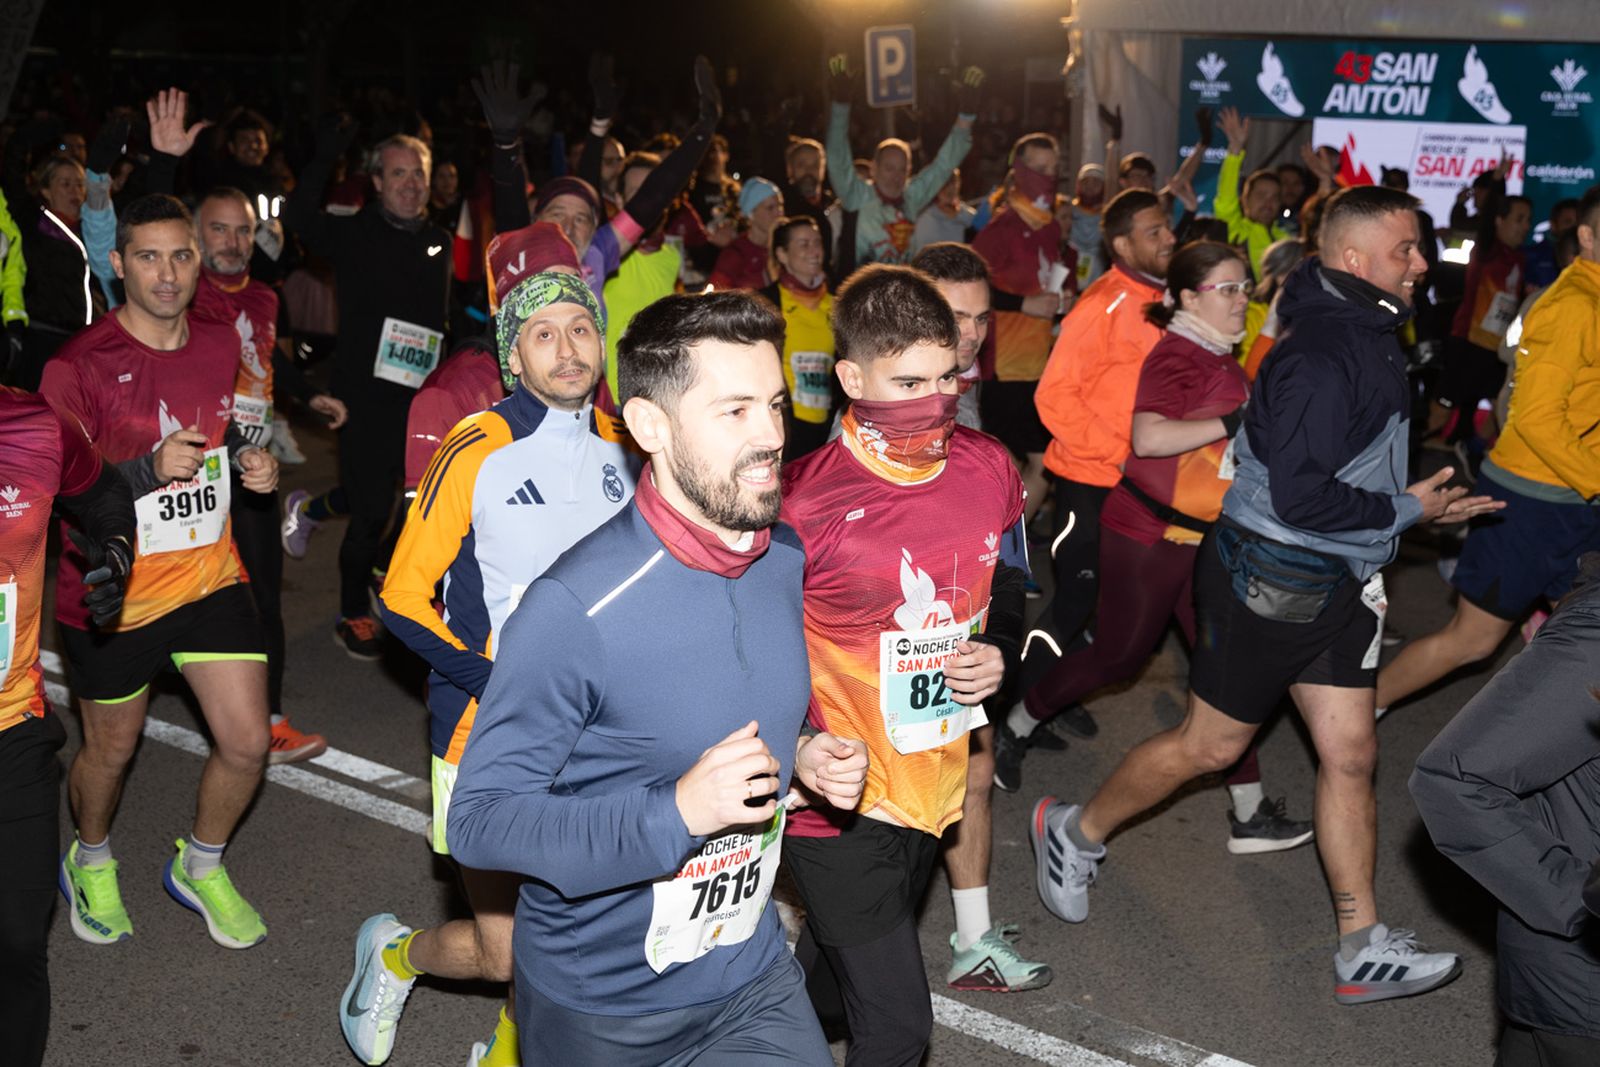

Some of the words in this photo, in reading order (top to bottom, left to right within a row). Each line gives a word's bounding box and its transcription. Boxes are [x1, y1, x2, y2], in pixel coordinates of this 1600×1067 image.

[878, 35, 906, 97] P
[1334, 50, 1373, 84] 43
[1372, 51, 1439, 82] SAN
[1322, 78, 1430, 116] ANTÓN
[1415, 155, 1465, 177] SAN
[1527, 163, 1594, 180] calderón
[157, 485, 217, 522] 3916
[912, 640, 950, 656] NOCHE
[951, 636, 964, 650] D
[896, 658, 923, 674] SAN
[909, 671, 953, 711] 82
[935, 706, 954, 718] César
[700, 834, 738, 858] OCHE
[709, 846, 753, 874] ANTÓN
[689, 855, 762, 921] 7615
